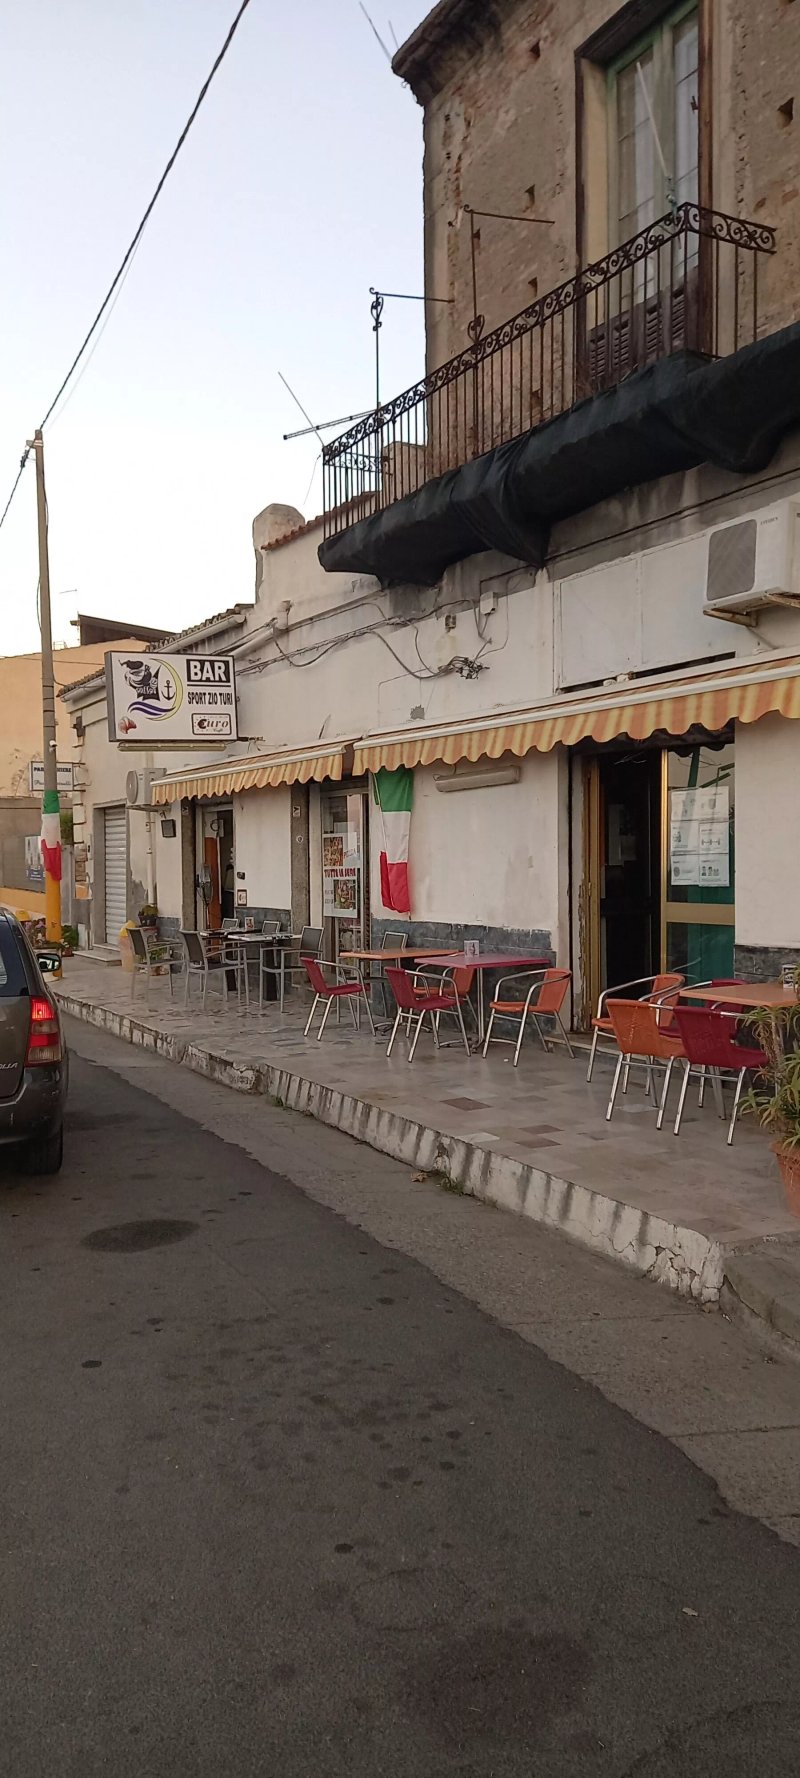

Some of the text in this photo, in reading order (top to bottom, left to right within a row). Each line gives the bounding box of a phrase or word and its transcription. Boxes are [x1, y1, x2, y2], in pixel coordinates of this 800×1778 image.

[190, 661, 227, 681] BAR
[188, 692, 233, 706] SPORT ZIO TURI
